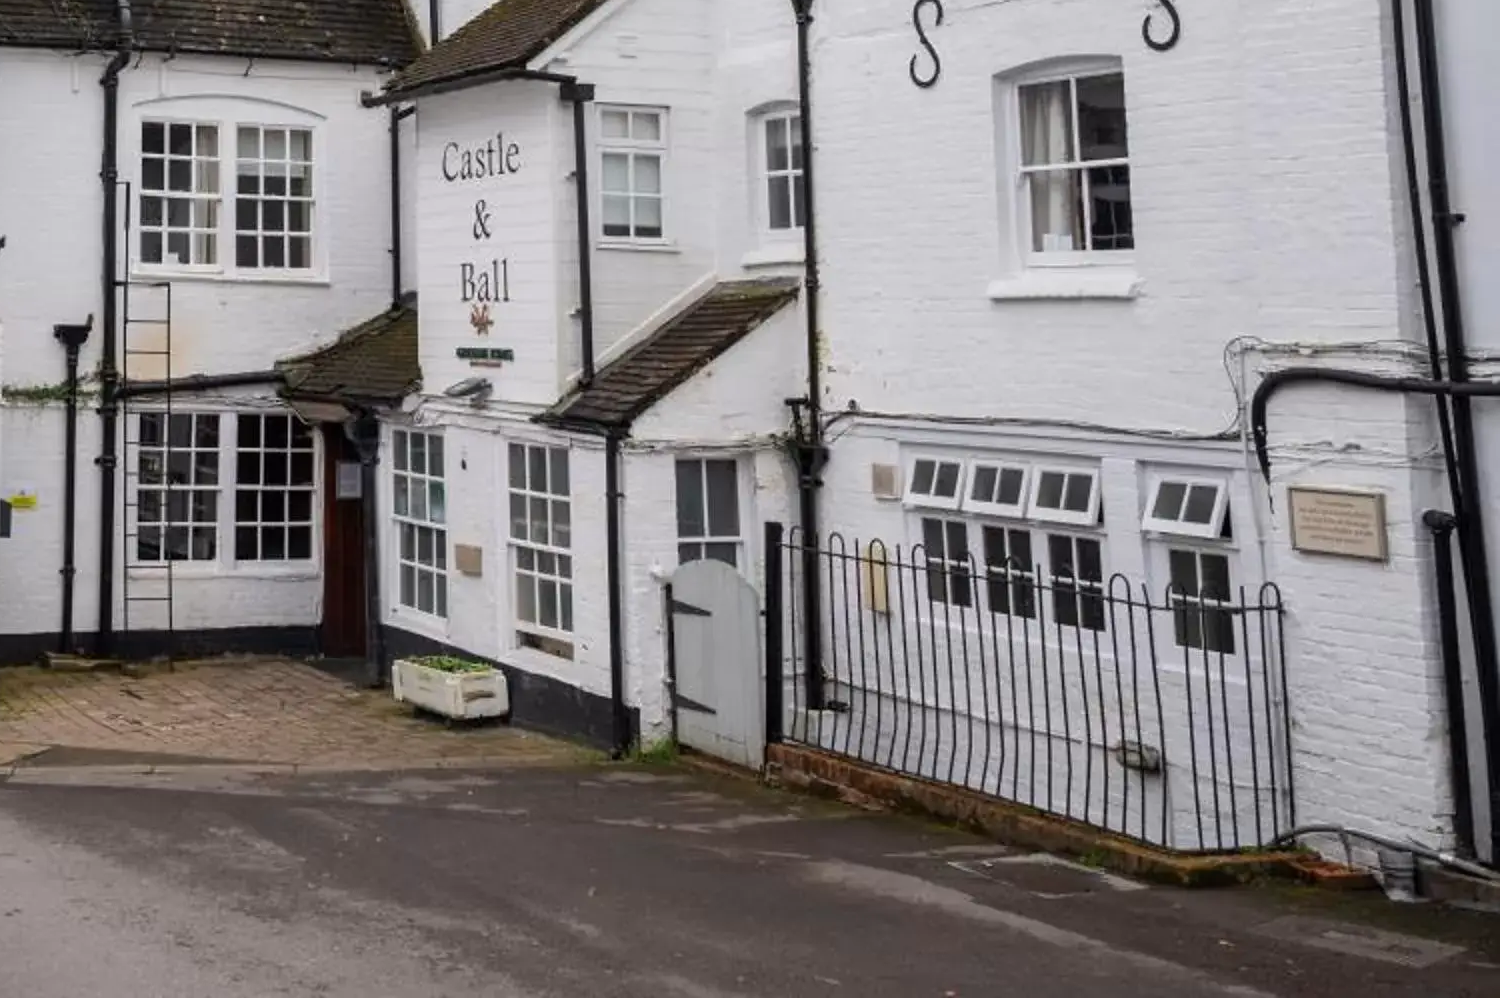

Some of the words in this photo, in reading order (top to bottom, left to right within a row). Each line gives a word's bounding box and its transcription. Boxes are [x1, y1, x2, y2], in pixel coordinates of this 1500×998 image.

[442, 132, 521, 182] Castle
[473, 199, 491, 240] &
[461, 258, 510, 303] Ball
